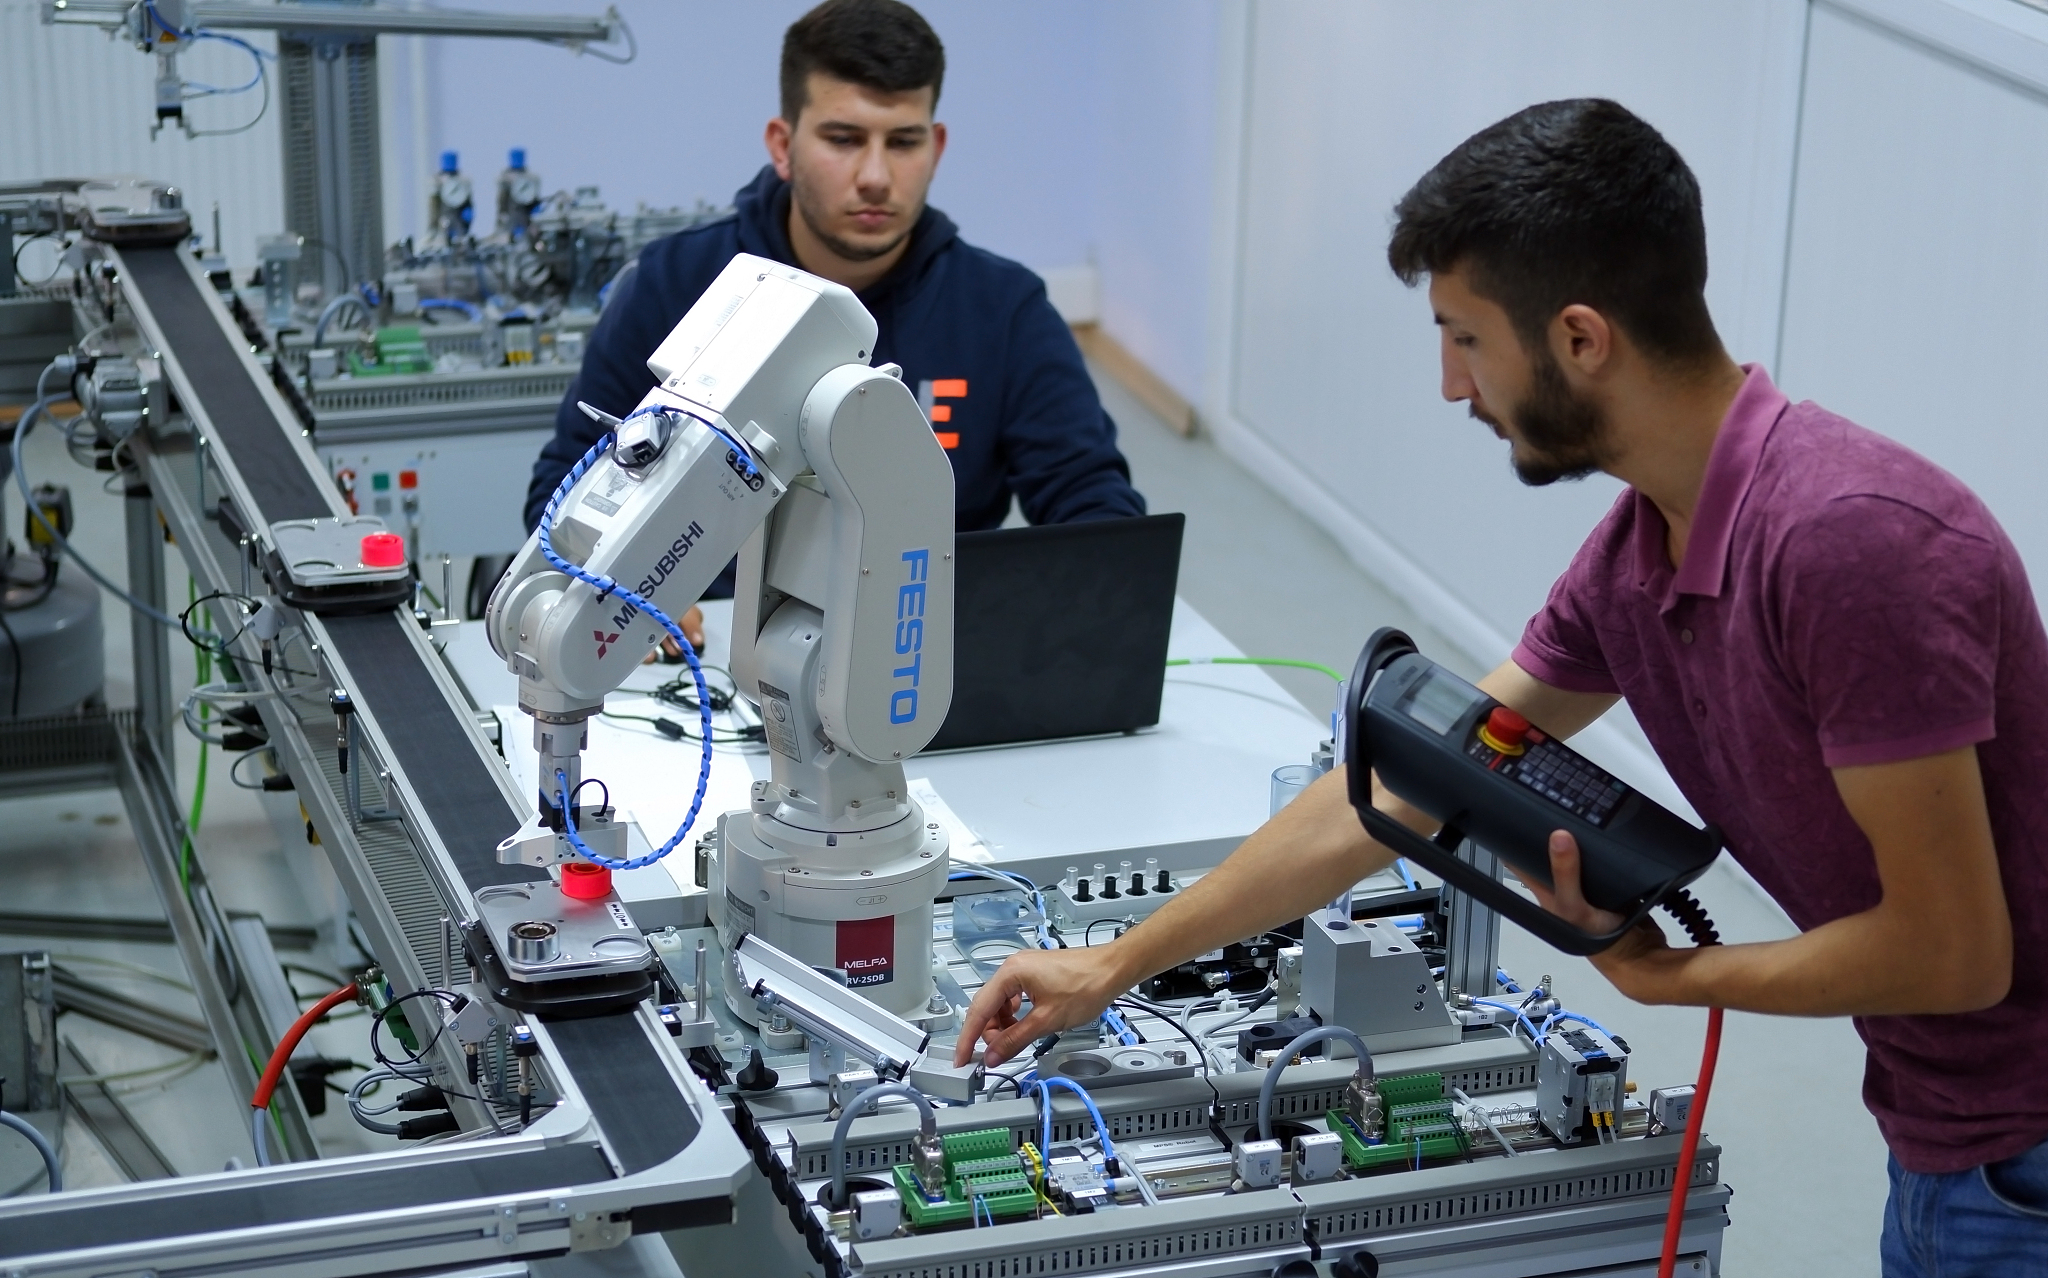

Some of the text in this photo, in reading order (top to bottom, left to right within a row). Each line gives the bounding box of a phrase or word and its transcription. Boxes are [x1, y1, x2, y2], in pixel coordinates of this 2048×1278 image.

[718, 483, 729, 494] OUT
[612, 520, 705, 631] MISUBISHI
[890, 549, 929, 725] FESTO
[844, 957, 888, 969] MELFA
[846, 973, 885, 985] RV-2SDB
